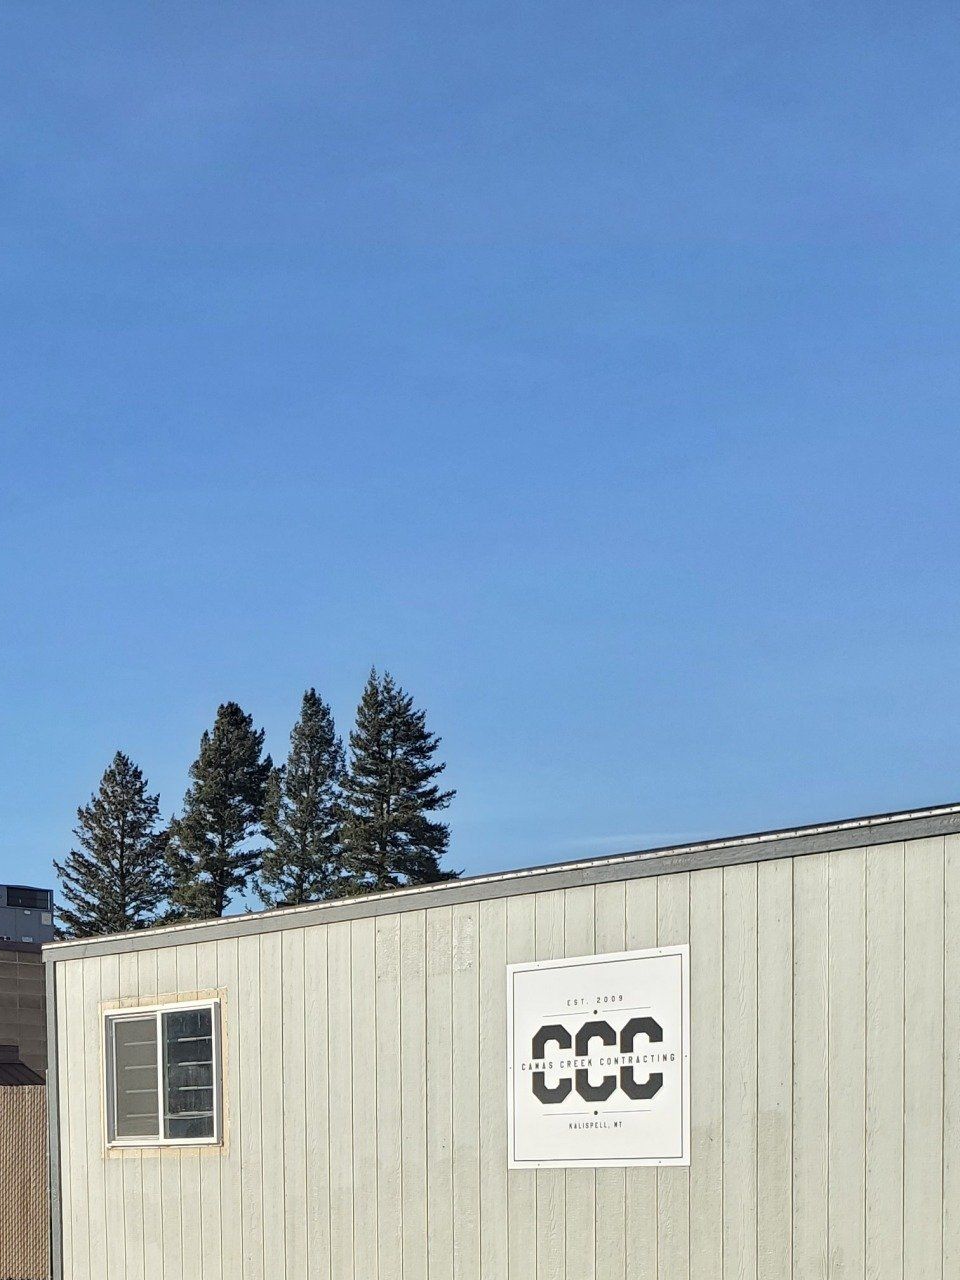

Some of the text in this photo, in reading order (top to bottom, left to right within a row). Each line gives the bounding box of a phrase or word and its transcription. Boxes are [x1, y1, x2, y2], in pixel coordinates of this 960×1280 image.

[596, 995, 623, 1003] 2009
[521, 1053, 676, 1071] CAMAS CREEK CONTRACTING
[531, 1016, 663, 1104] CCC
[569, 1121, 610, 1130] KALISPELL,
